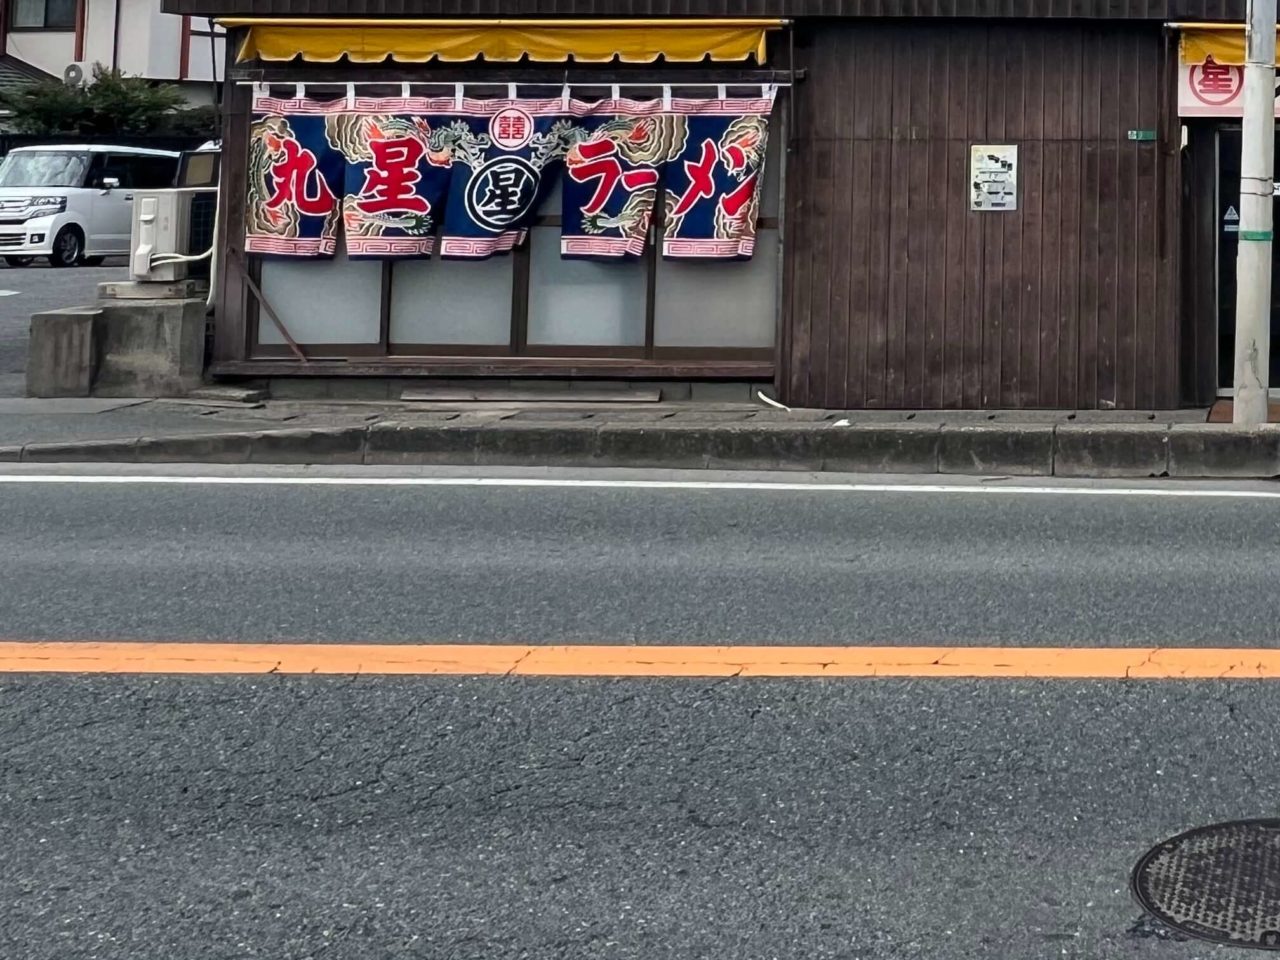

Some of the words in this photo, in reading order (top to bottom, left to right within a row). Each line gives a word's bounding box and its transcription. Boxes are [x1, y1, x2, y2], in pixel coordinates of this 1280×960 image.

[478, 166, 528, 221] 星
[568, 138, 759, 217] ラーメン
